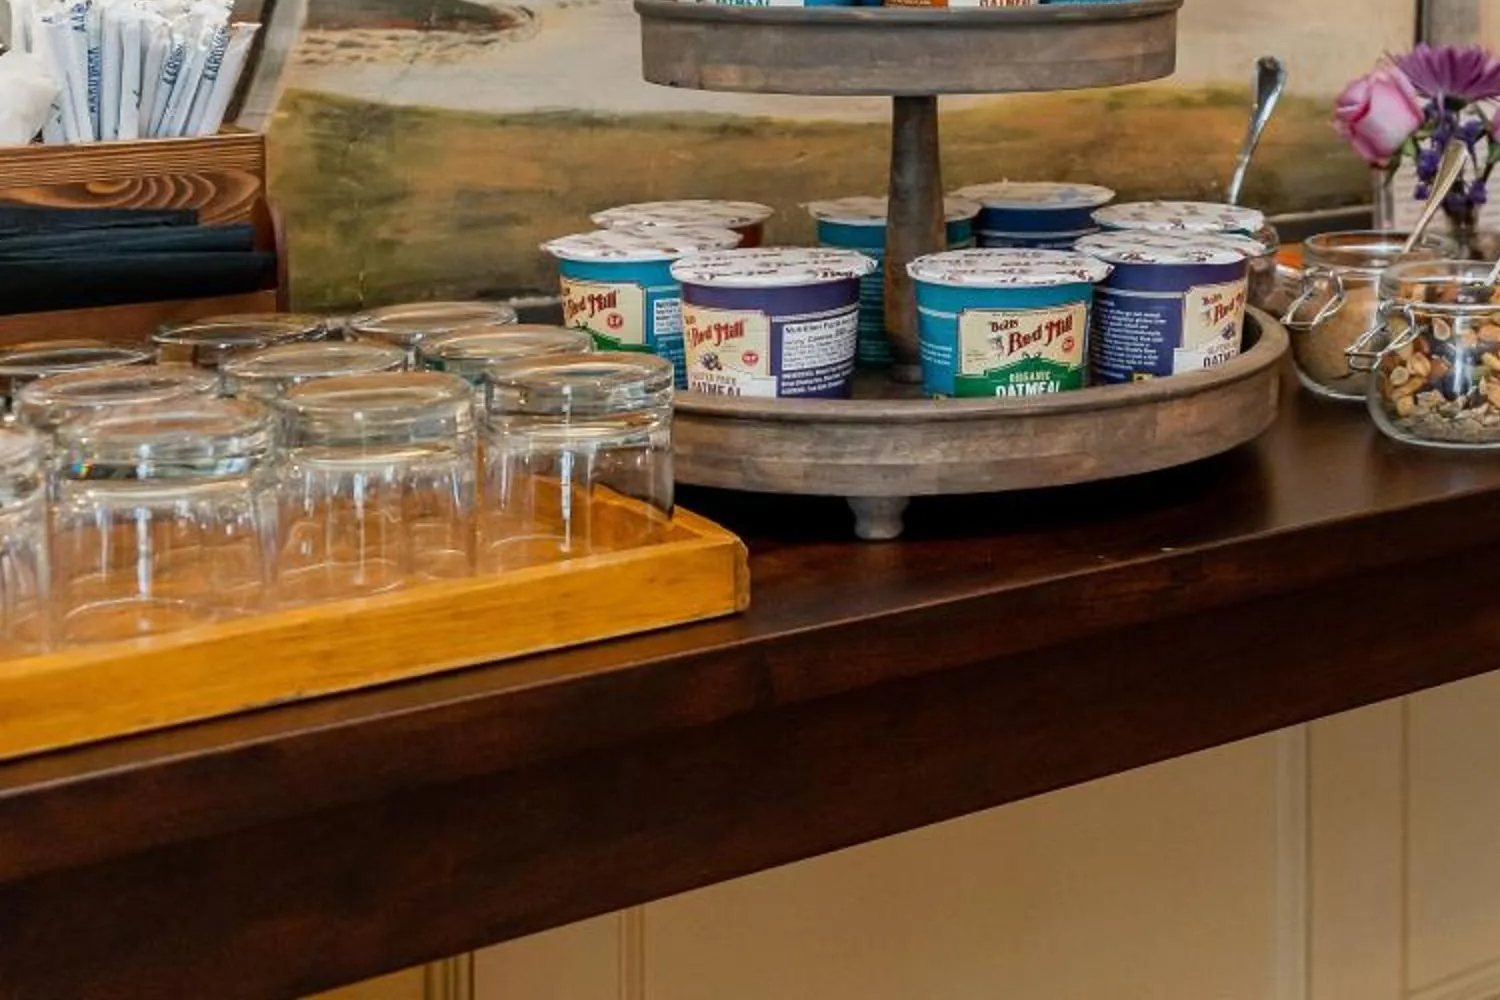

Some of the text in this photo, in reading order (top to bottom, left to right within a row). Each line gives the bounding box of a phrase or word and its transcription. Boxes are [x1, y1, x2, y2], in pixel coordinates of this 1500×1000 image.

[587, 290, 617, 318] Mill
[692, 320, 744, 348] Red Mill
[1008, 315, 1073, 356] Red Mill
[1009, 371, 1051, 383] ORGANIC
